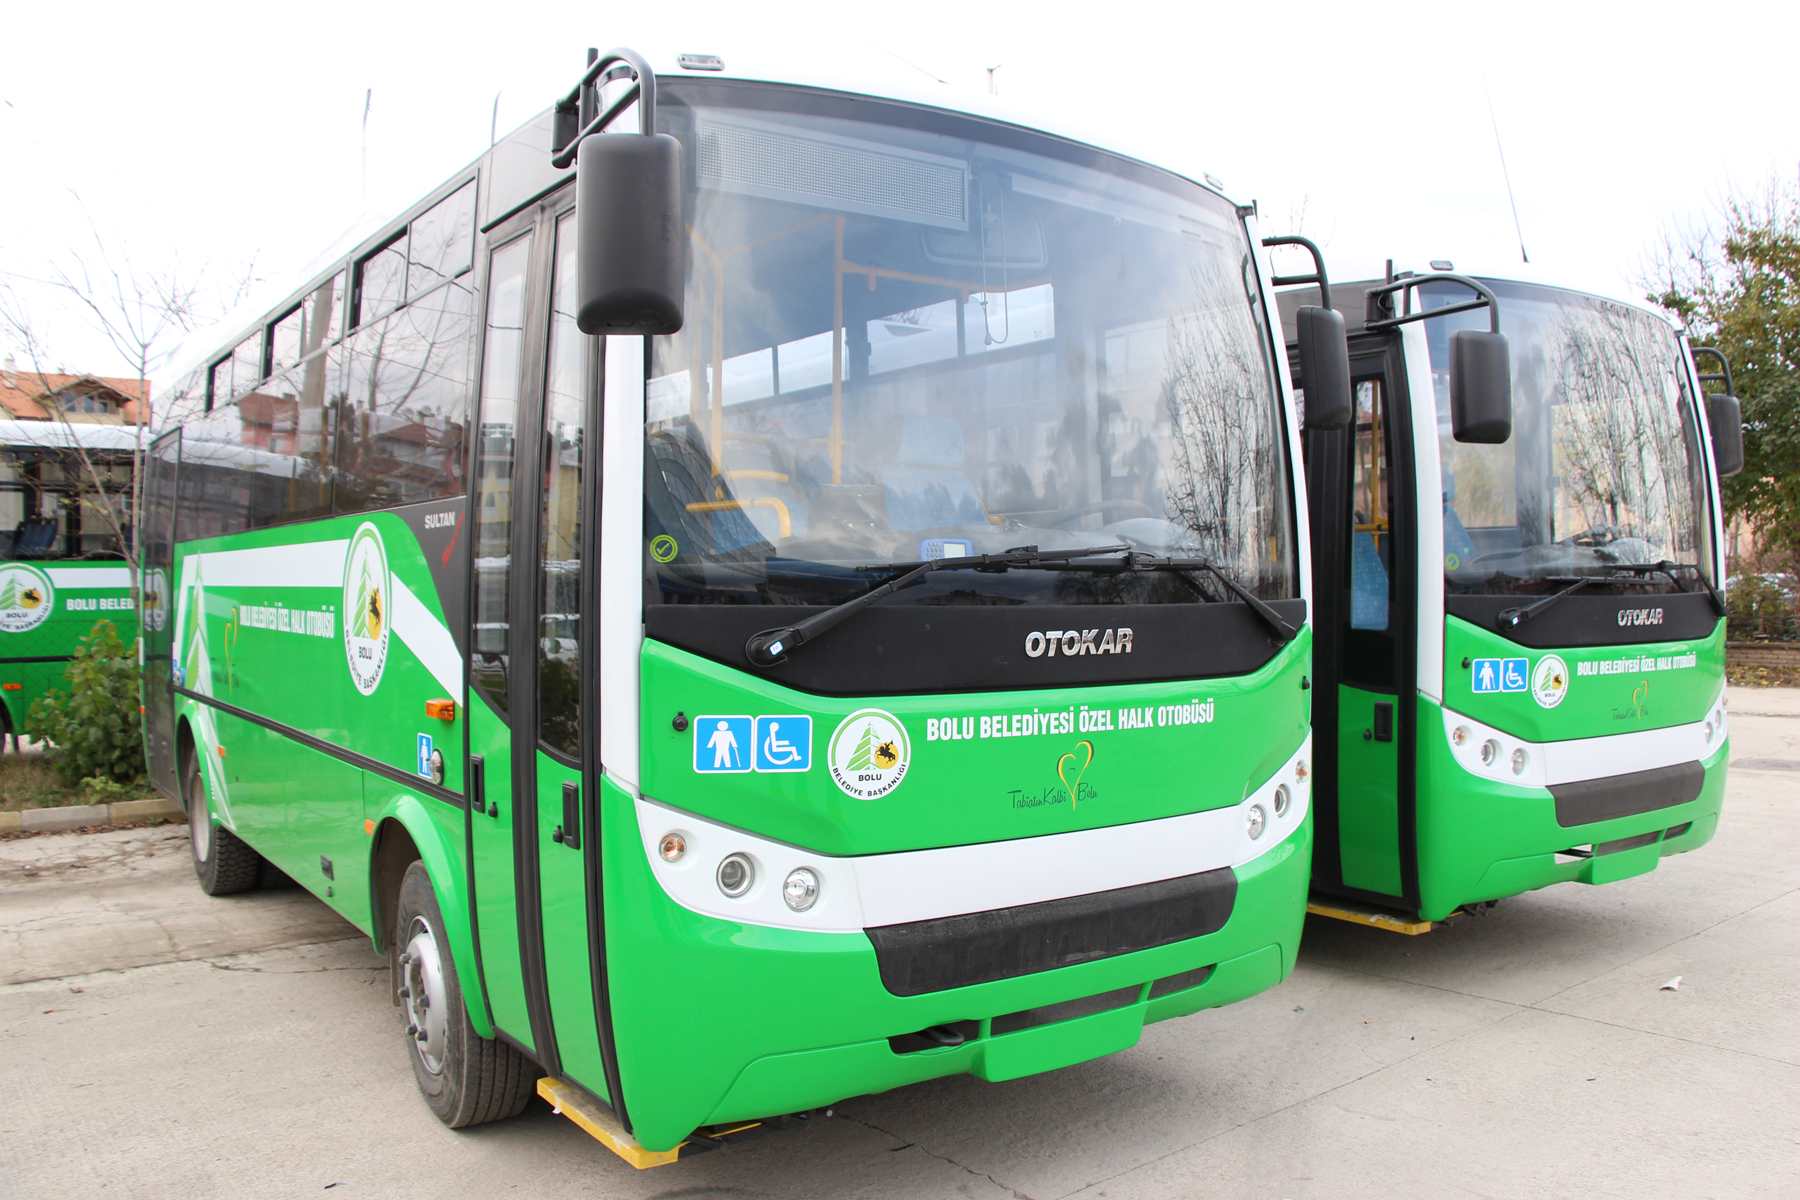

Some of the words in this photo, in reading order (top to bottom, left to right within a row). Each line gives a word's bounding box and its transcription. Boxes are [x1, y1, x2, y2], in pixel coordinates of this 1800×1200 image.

[424, 511, 455, 529] SULTAN
[65, 598, 97, 611] BOLU
[290, 609, 306, 635] HALK
[306, 605, 335, 639] OTOBÜSÜ
[1617, 608, 1664, 626] OTOKAR
[1025, 628, 1134, 658] OTOKAR
[358, 646, 373, 660] BOLU
[1577, 661, 1599, 676] BOLU
[1599, 656, 1641, 675] BELEDİYESİ
[1641, 655, 1657, 672] ÖZEL
[1656, 656, 1673, 671] HALK
[926, 717, 975, 741] BOLU
[979, 706, 1075, 739] BELEDİYESİ
[1078, 705, 1115, 732] ÖZEL
[1118, 707, 1154, 730] HALK
[1157, 697, 1215, 727] OTOBÜSÜ
[832, 766, 863, 797] BELEDİYE
[867, 763, 907, 797] BAŞKANLIĞI
[858, 773, 882, 782] BOLU
[1077, 782, 1098, 801] Bolu
